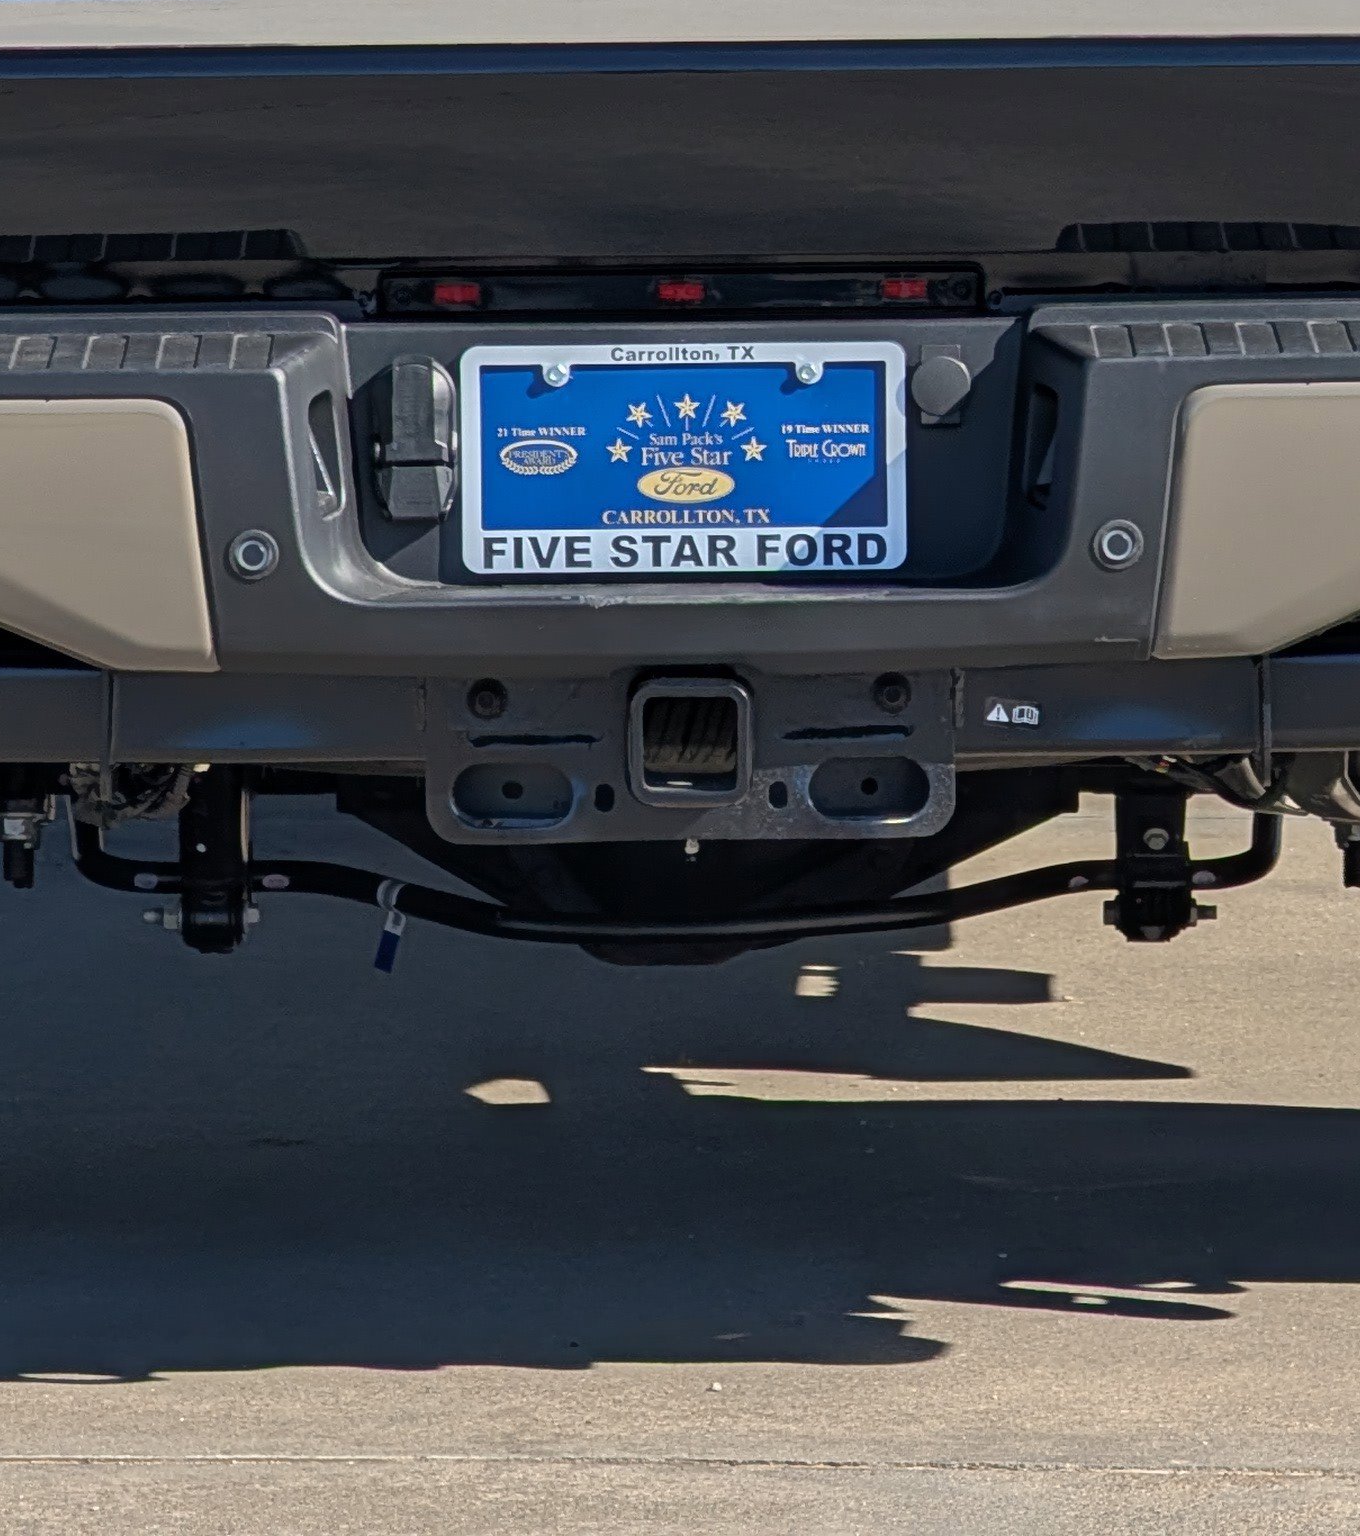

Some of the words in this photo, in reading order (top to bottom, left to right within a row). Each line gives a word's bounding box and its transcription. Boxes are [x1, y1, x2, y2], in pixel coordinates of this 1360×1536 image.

[611, 347, 720, 363] Carrollton,
[726, 346, 755, 361] TX
[511, 427, 536, 437] Time
[538, 426, 586, 437] WINNER
[781, 424, 793, 434] 19
[795, 424, 820, 434] Time
[822, 424, 870, 434] WINNER
[649, 433, 678, 446] Sam
[682, 431, 723, 445] Pack's
[641, 447, 684, 466] Five
[690, 447, 733, 466] Star
[653, 470, 718, 496] Ford
[602, 509, 740, 525] CARROLLTON,
[743, 509, 770, 524] TX
[483, 536, 592, 569] FIVE
[610, 534, 737, 567] STAR
[757, 533, 887, 566] FORD
